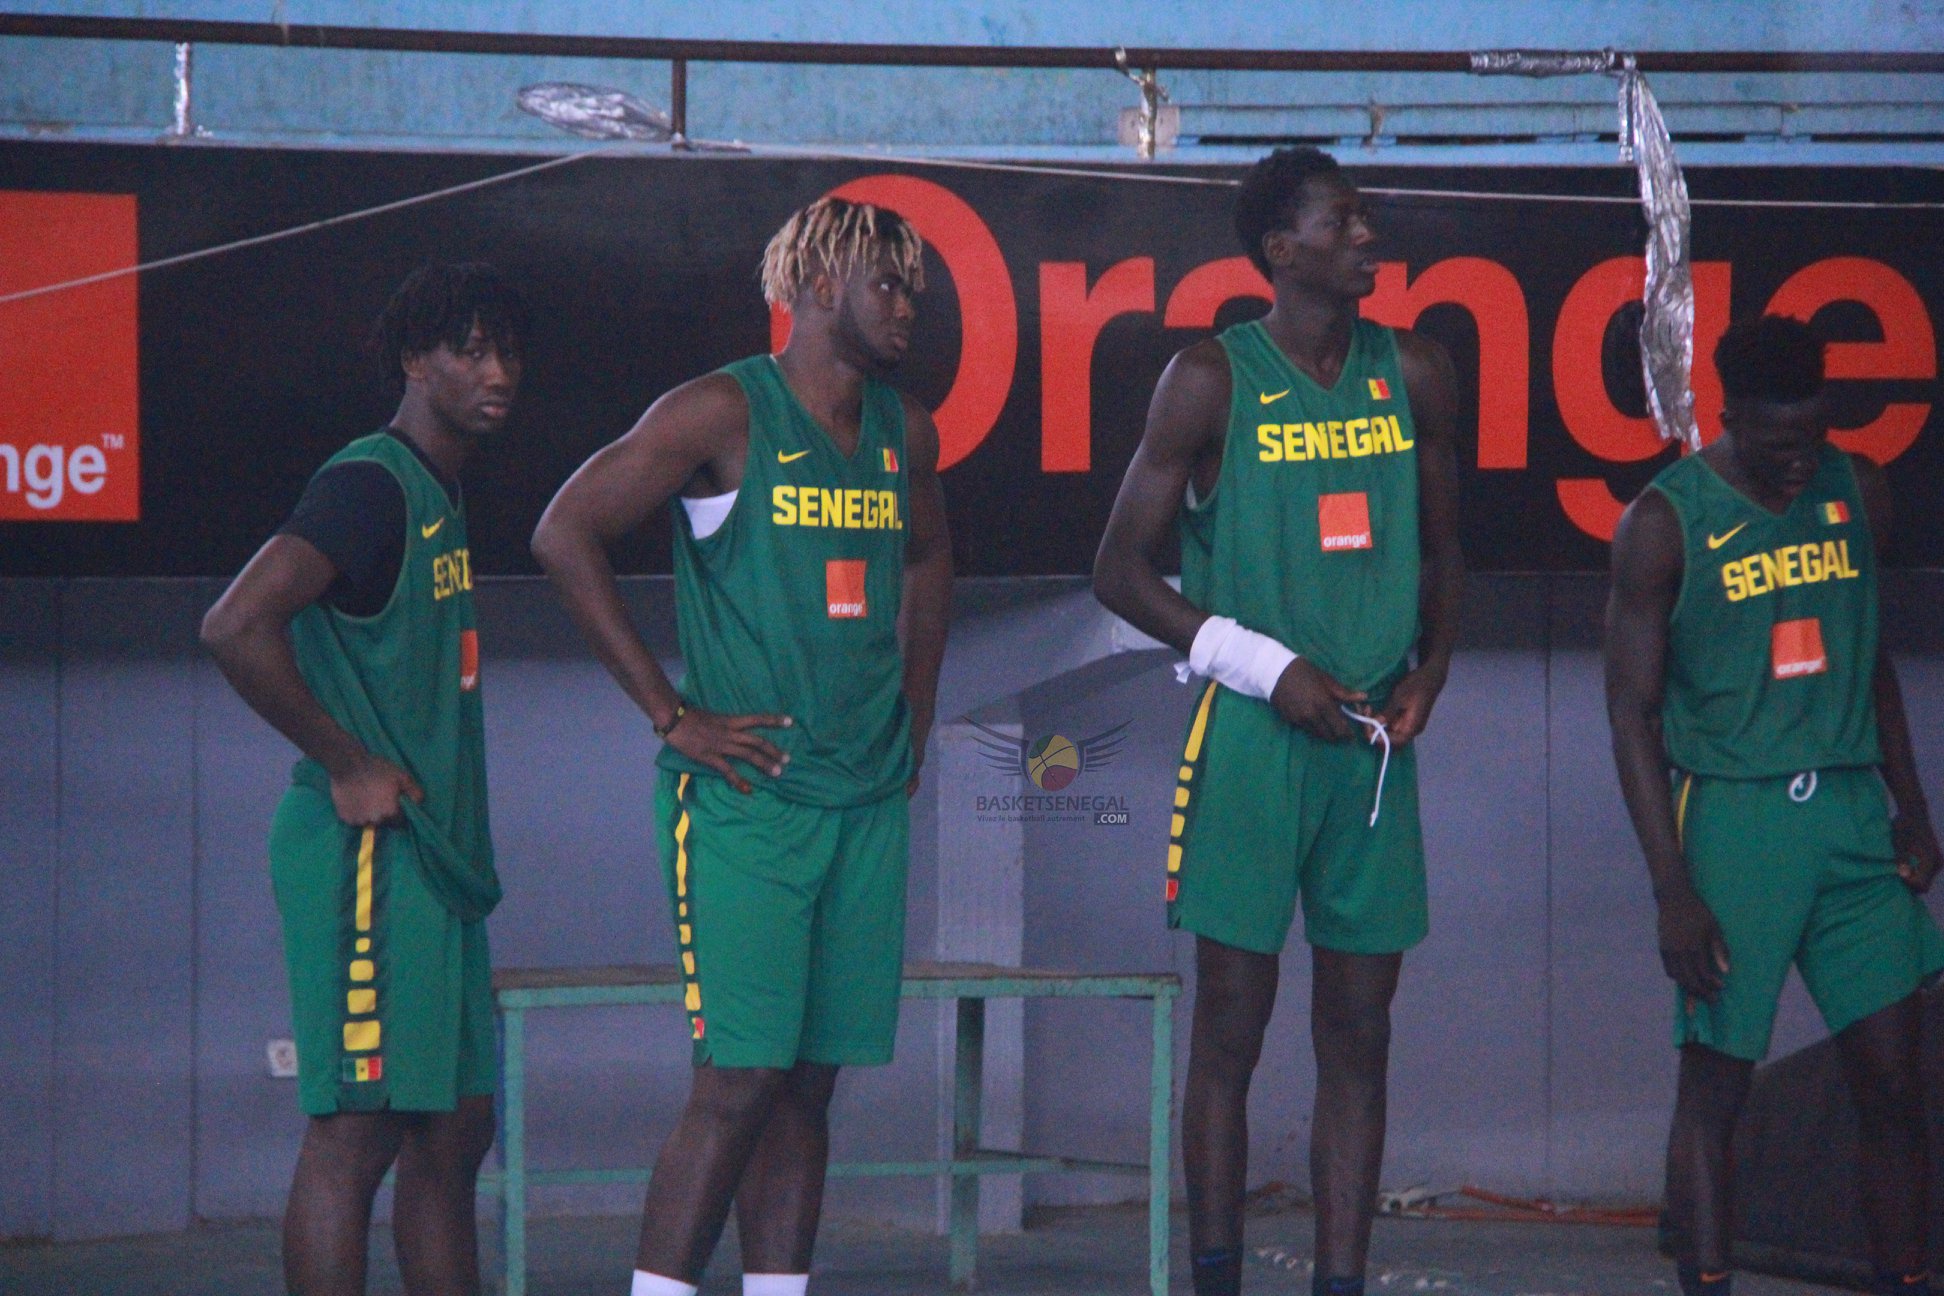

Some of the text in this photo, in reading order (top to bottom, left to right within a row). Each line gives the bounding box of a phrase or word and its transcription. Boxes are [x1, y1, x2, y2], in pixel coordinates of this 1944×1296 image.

[1257, 415, 1414, 462] SENEGAL
[772, 485, 903, 530] SENEGAL
[1323, 533, 1367, 549] orange
[1721, 540, 1859, 602] SENEGAL
